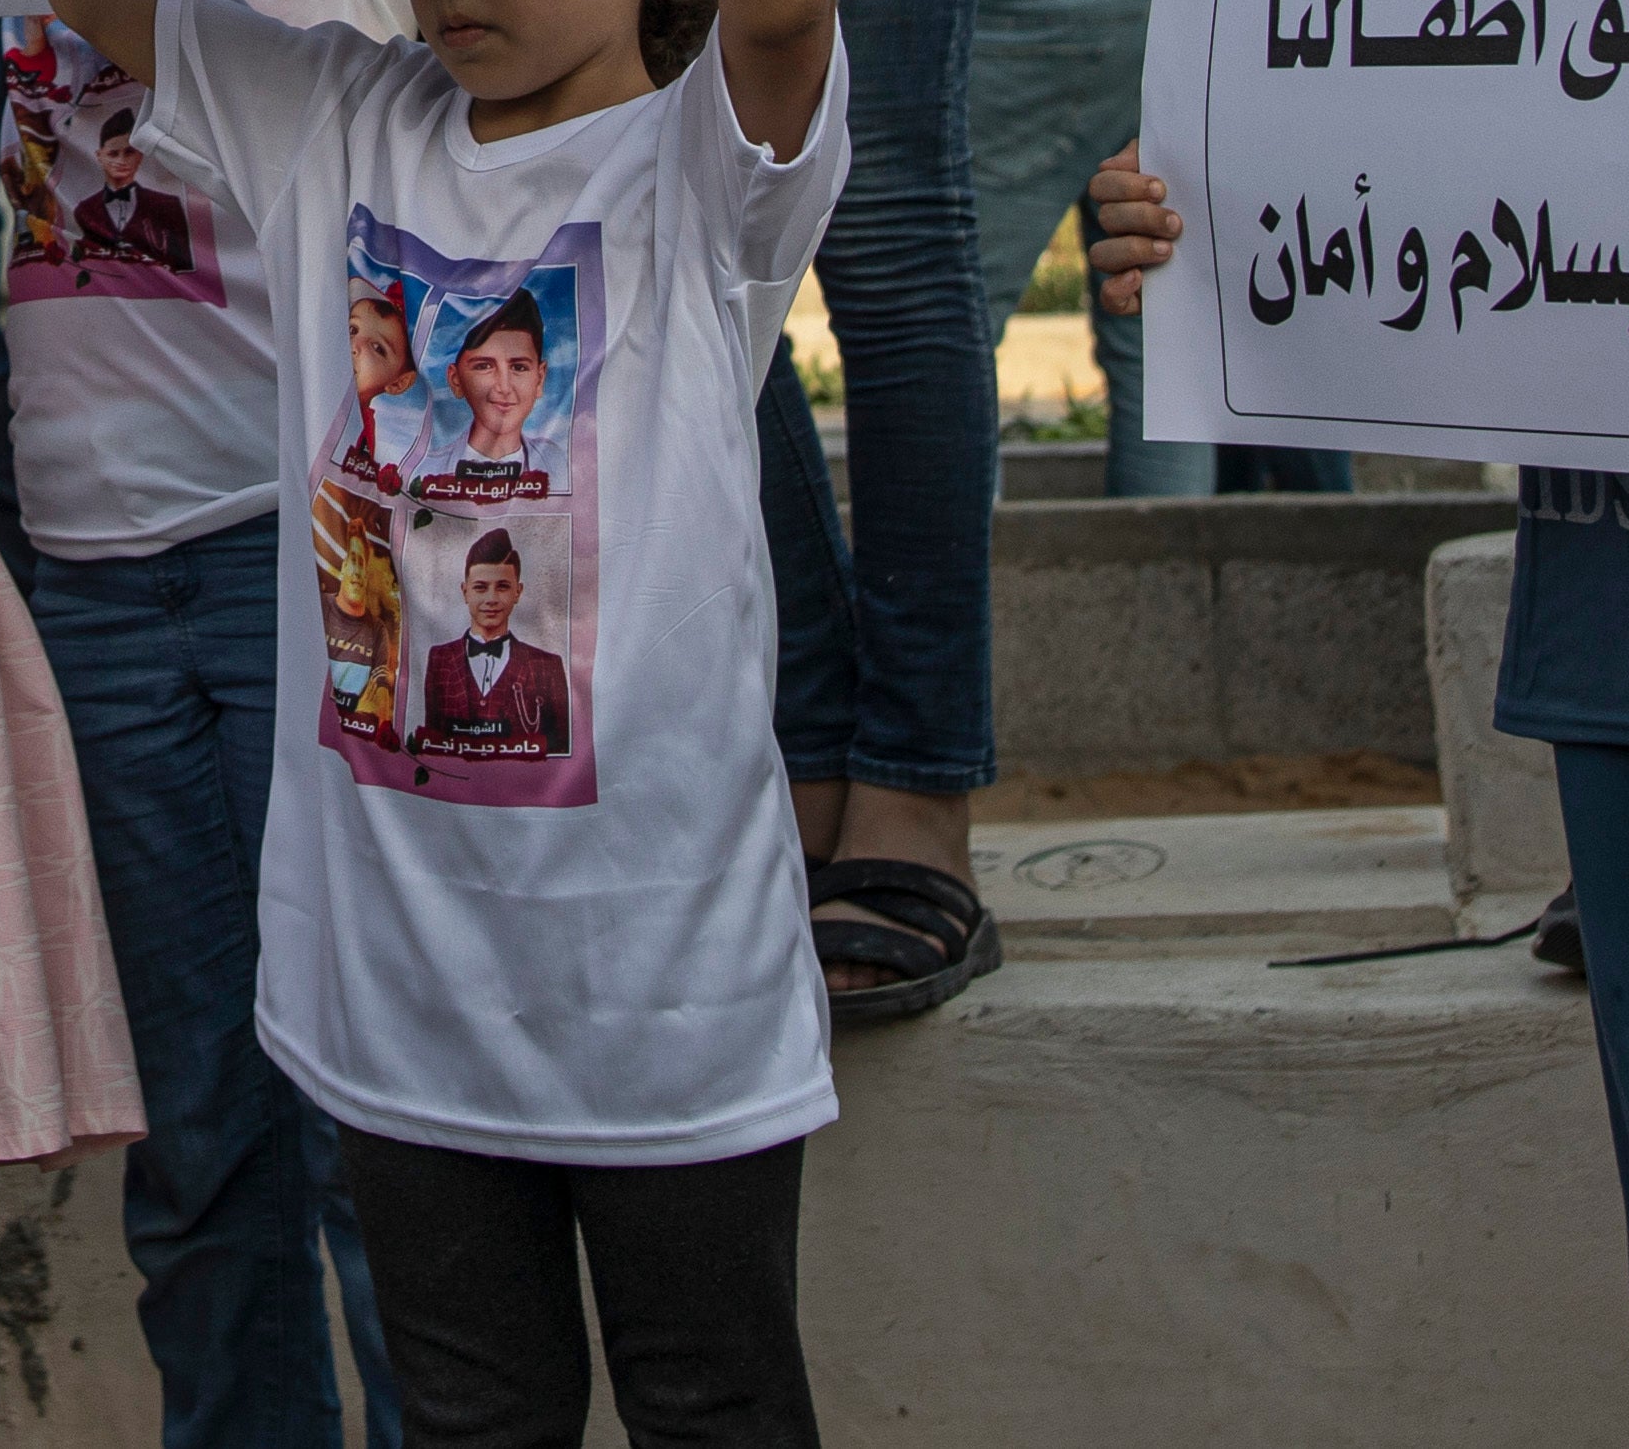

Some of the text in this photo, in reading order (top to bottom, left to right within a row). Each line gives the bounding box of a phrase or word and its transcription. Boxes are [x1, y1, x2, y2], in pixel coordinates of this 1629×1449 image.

[465, 465, 514, 478] الشهيد
[425, 482, 461, 494] نجم
[511, 480, 541, 495] جميل
[452, 722, 502, 733] الشهيد
[422, 737, 540, 754] حامد حيدر نجم
